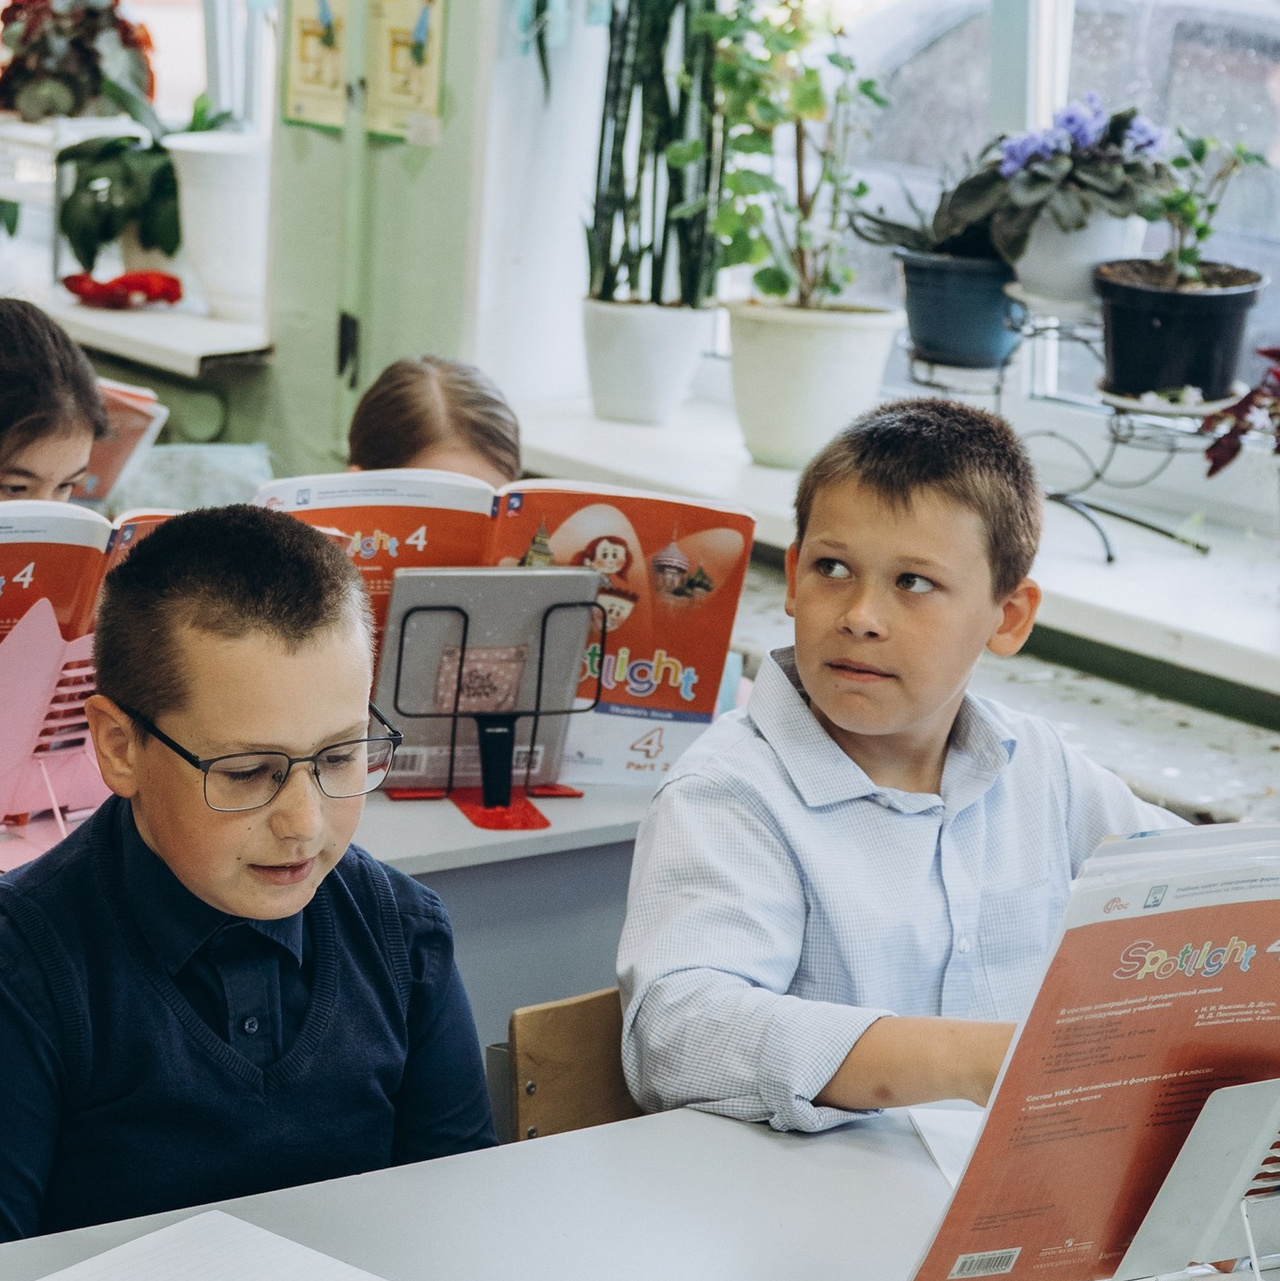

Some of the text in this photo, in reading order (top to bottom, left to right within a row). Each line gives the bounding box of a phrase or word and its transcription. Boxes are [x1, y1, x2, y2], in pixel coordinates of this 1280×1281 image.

[346, 525, 428, 559] light 4
[12, 562, 36, 589] 4
[579, 643, 699, 701] tlight
[630, 727, 665, 759] 4
[626, 760, 657, 771] Part
[1113, 936, 1257, 980] Spotlight
[1053, 1088, 1070, 1096] УМК
